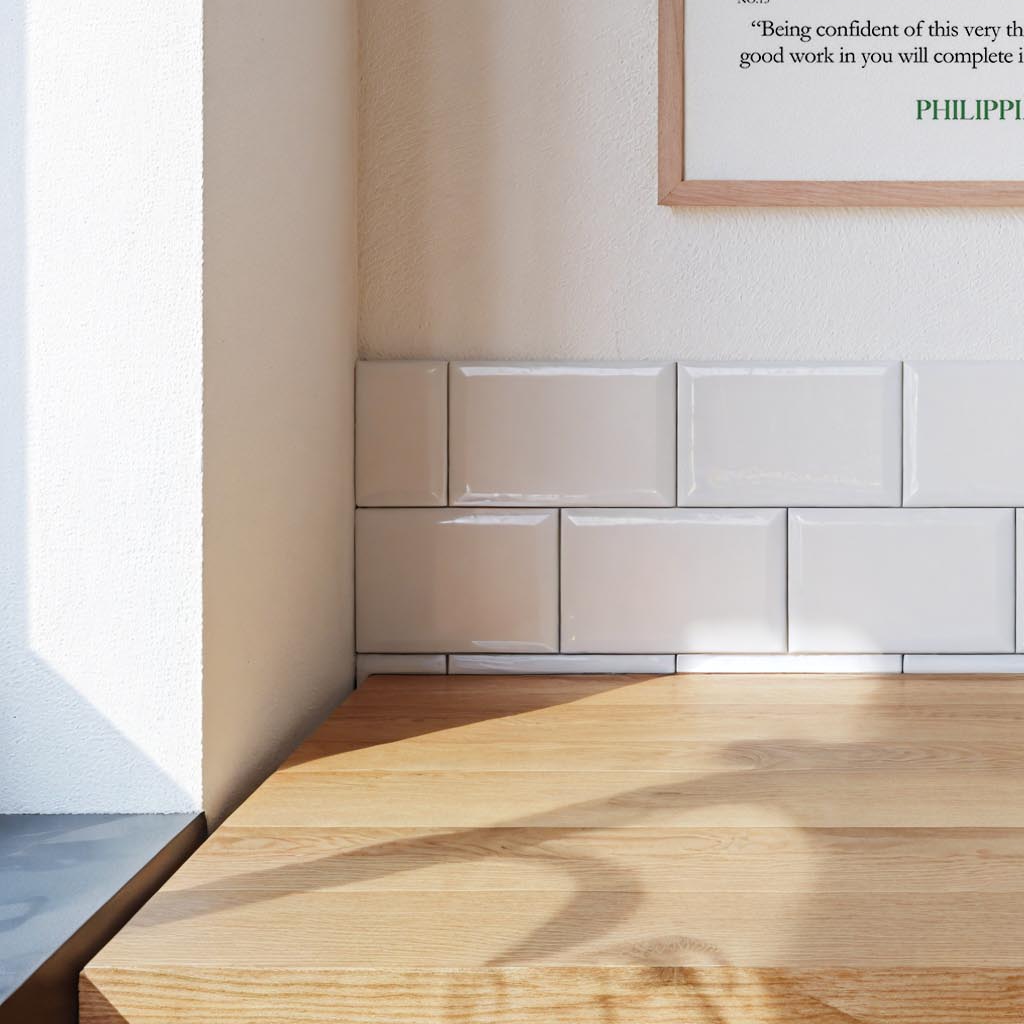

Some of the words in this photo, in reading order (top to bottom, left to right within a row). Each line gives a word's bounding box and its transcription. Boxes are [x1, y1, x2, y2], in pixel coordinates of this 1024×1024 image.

[752, 20, 812, 42] “Being
[816, 20, 899, 37] confident
[904, 20, 926, 37] of
[928, 20, 958, 37] this
[964, 26, 1001, 42] very
[739, 46, 784, 69] good
[789, 47, 834, 63] work
[840, 47, 856, 63] in
[861, 52, 893, 69] you
[898, 47, 928, 63] will
[934, 47, 1013, 69] complete
